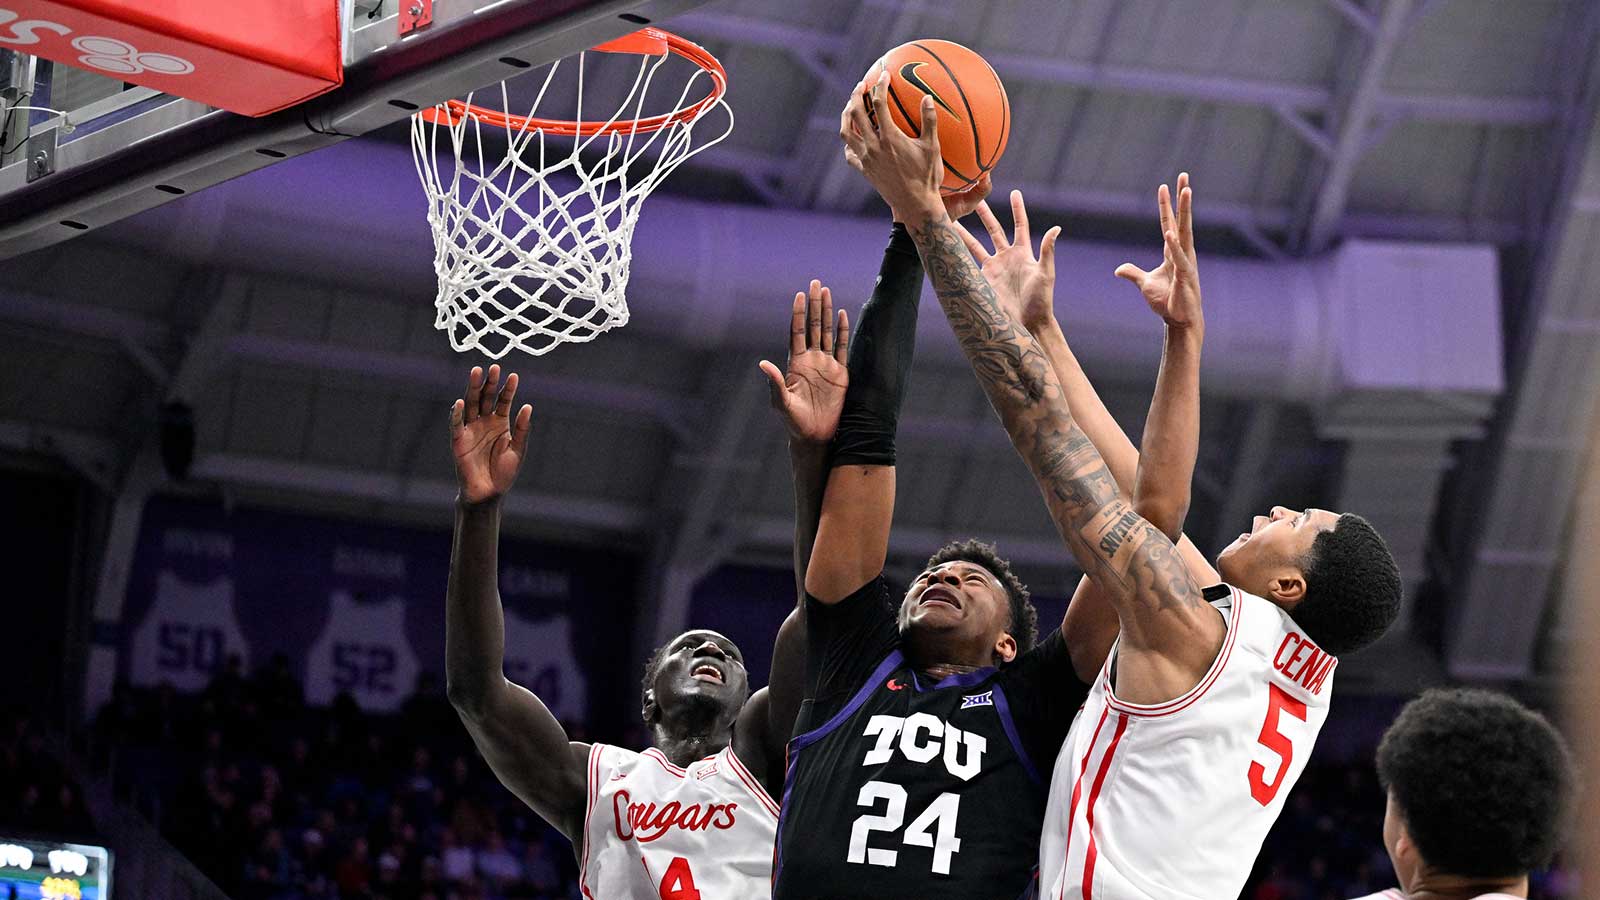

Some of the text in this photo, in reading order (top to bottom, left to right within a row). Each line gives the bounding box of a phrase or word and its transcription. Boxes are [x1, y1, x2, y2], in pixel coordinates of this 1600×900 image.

[158, 623, 225, 673] 50
[333, 643, 396, 694] 52
[863, 712, 986, 781] TCU
[1248, 681, 1307, 807] 5
[613, 790, 737, 842] Cougars
[847, 781, 961, 875] 24
